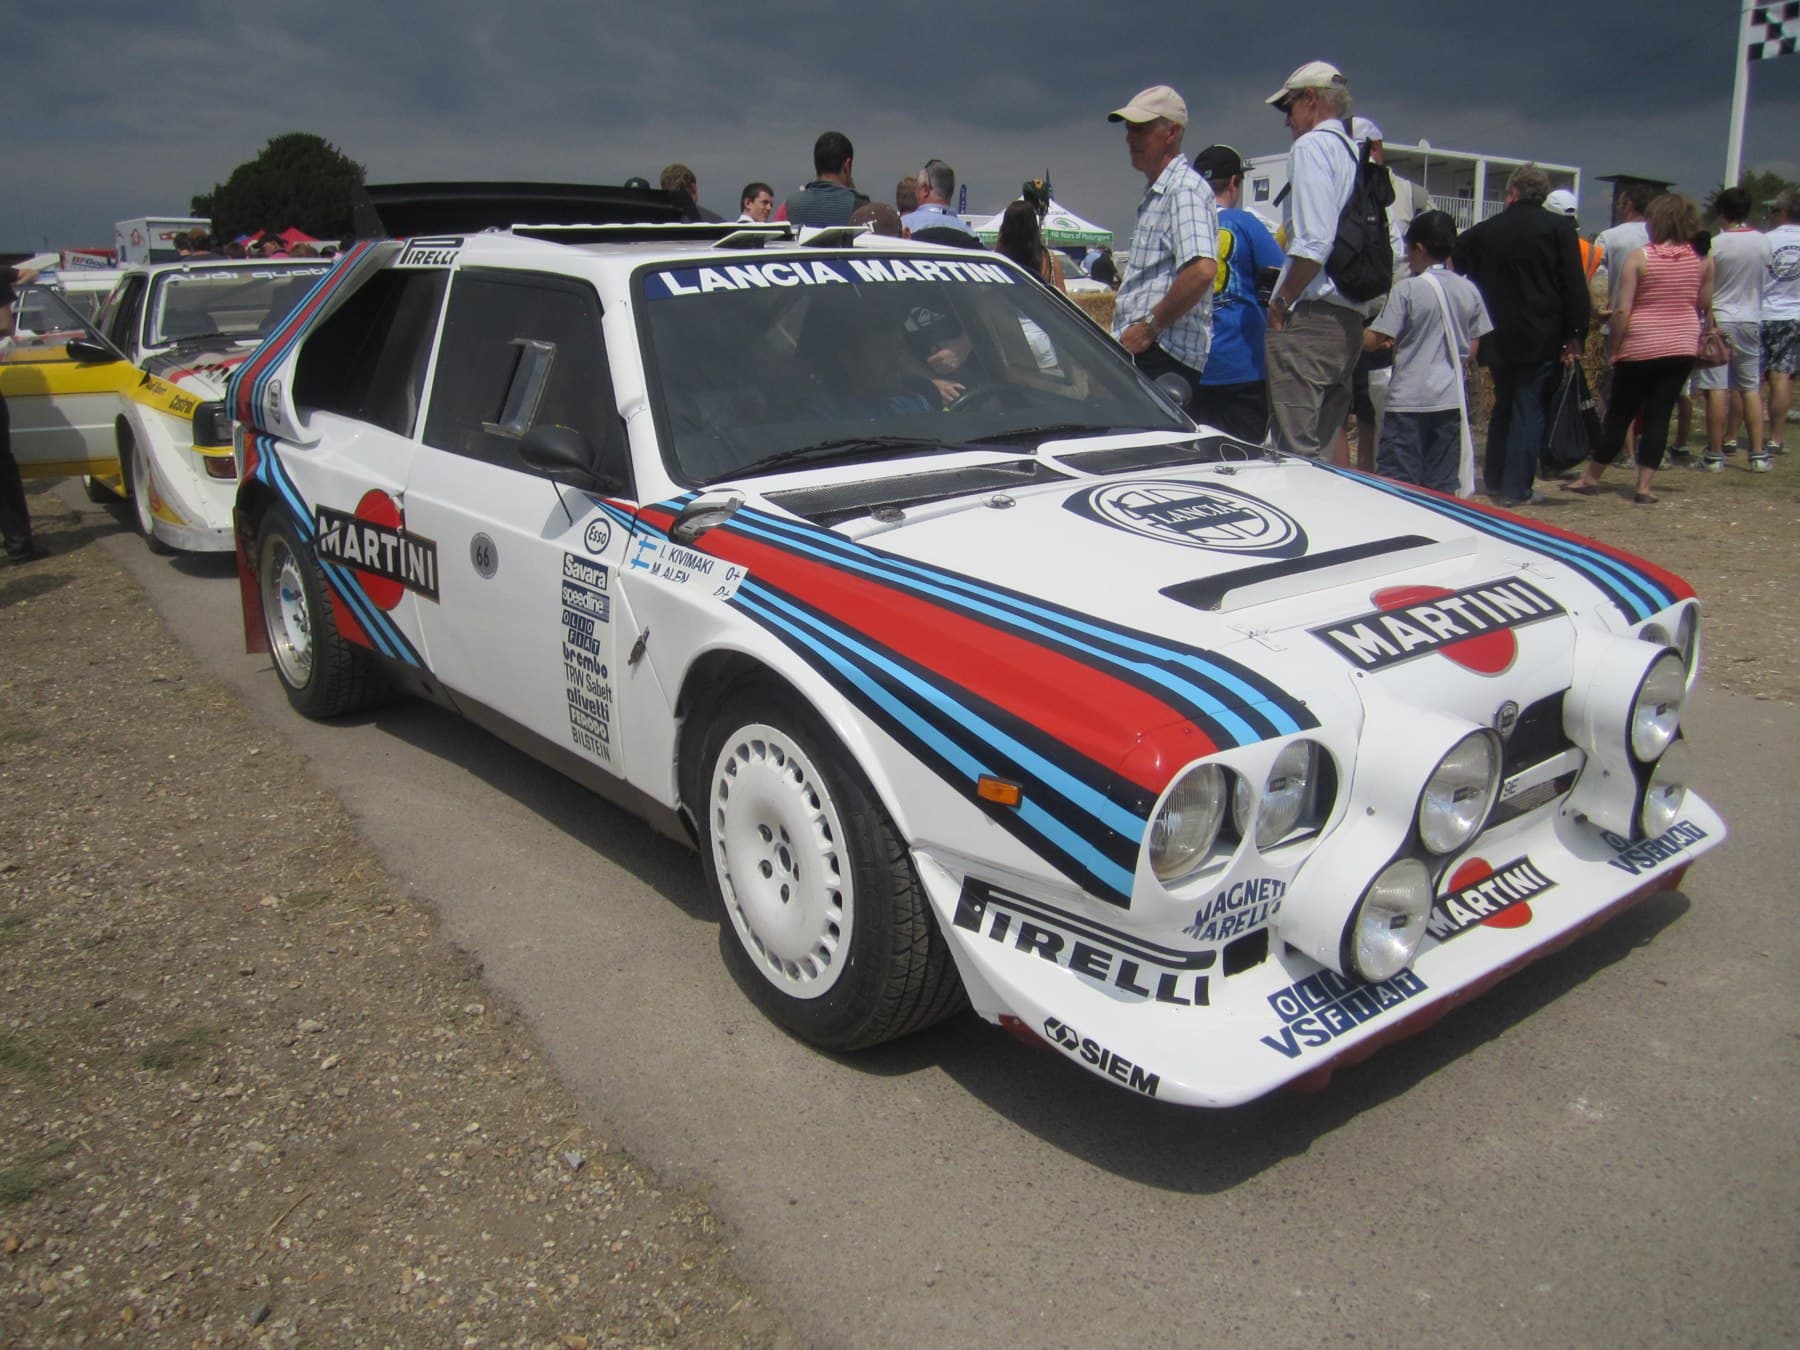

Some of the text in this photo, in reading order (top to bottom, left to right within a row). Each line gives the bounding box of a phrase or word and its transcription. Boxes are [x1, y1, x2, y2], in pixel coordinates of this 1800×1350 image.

[399, 237, 464, 265] PIRELLI
[166, 267, 329, 281] Audi quatt
[658, 259, 1016, 297] LANCIA MARTINI
[1149, 501, 1240, 524] LANCIA
[319, 515, 435, 591] MARTINI
[476, 546, 490, 568] 66
[668, 547, 715, 575] KIVIMAKI
[564, 554, 608, 589] Savara
[562, 582, 604, 615] speedline
[562, 610, 595, 636] OLIO
[1327, 578, 1554, 664] MARTINI
[562, 641, 609, 678] brembo
[568, 629, 600, 655] FIAT
[564, 662, 614, 704] TRW Sabelt
[567, 688, 610, 722] olivetti
[570, 705, 609, 741] FERODO
[571, 729, 611, 762] BILSTEIN
[1194, 877, 1287, 928] MAGNETI
[1427, 863, 1548, 937] MARTINI
[953, 875, 1217, 1007] PIRELLI
[1271, 969, 1352, 1020] OLI
[1079, 1038, 1161, 1098] SIEM
